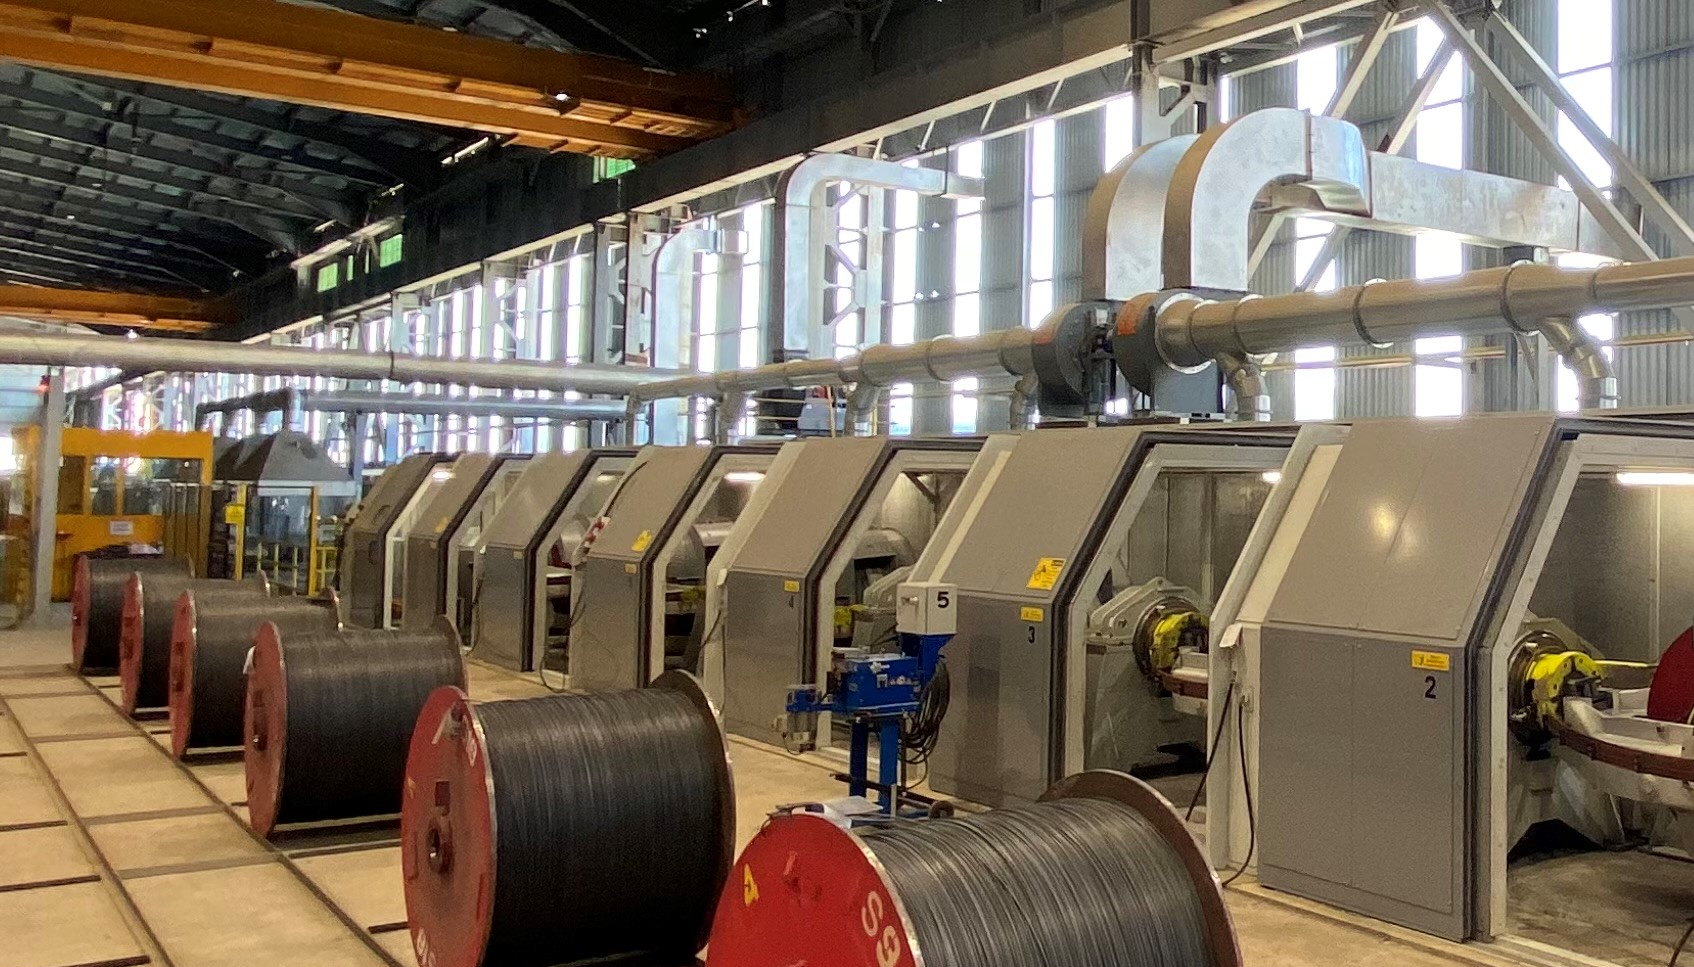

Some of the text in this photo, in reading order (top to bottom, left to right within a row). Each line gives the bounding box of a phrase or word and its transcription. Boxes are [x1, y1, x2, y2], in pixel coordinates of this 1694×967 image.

[937, 592, 949, 608] 5
[1028, 626, 1035, 643] 3
[1425, 675, 1436, 699] 2
[744, 863, 759, 907] 4
